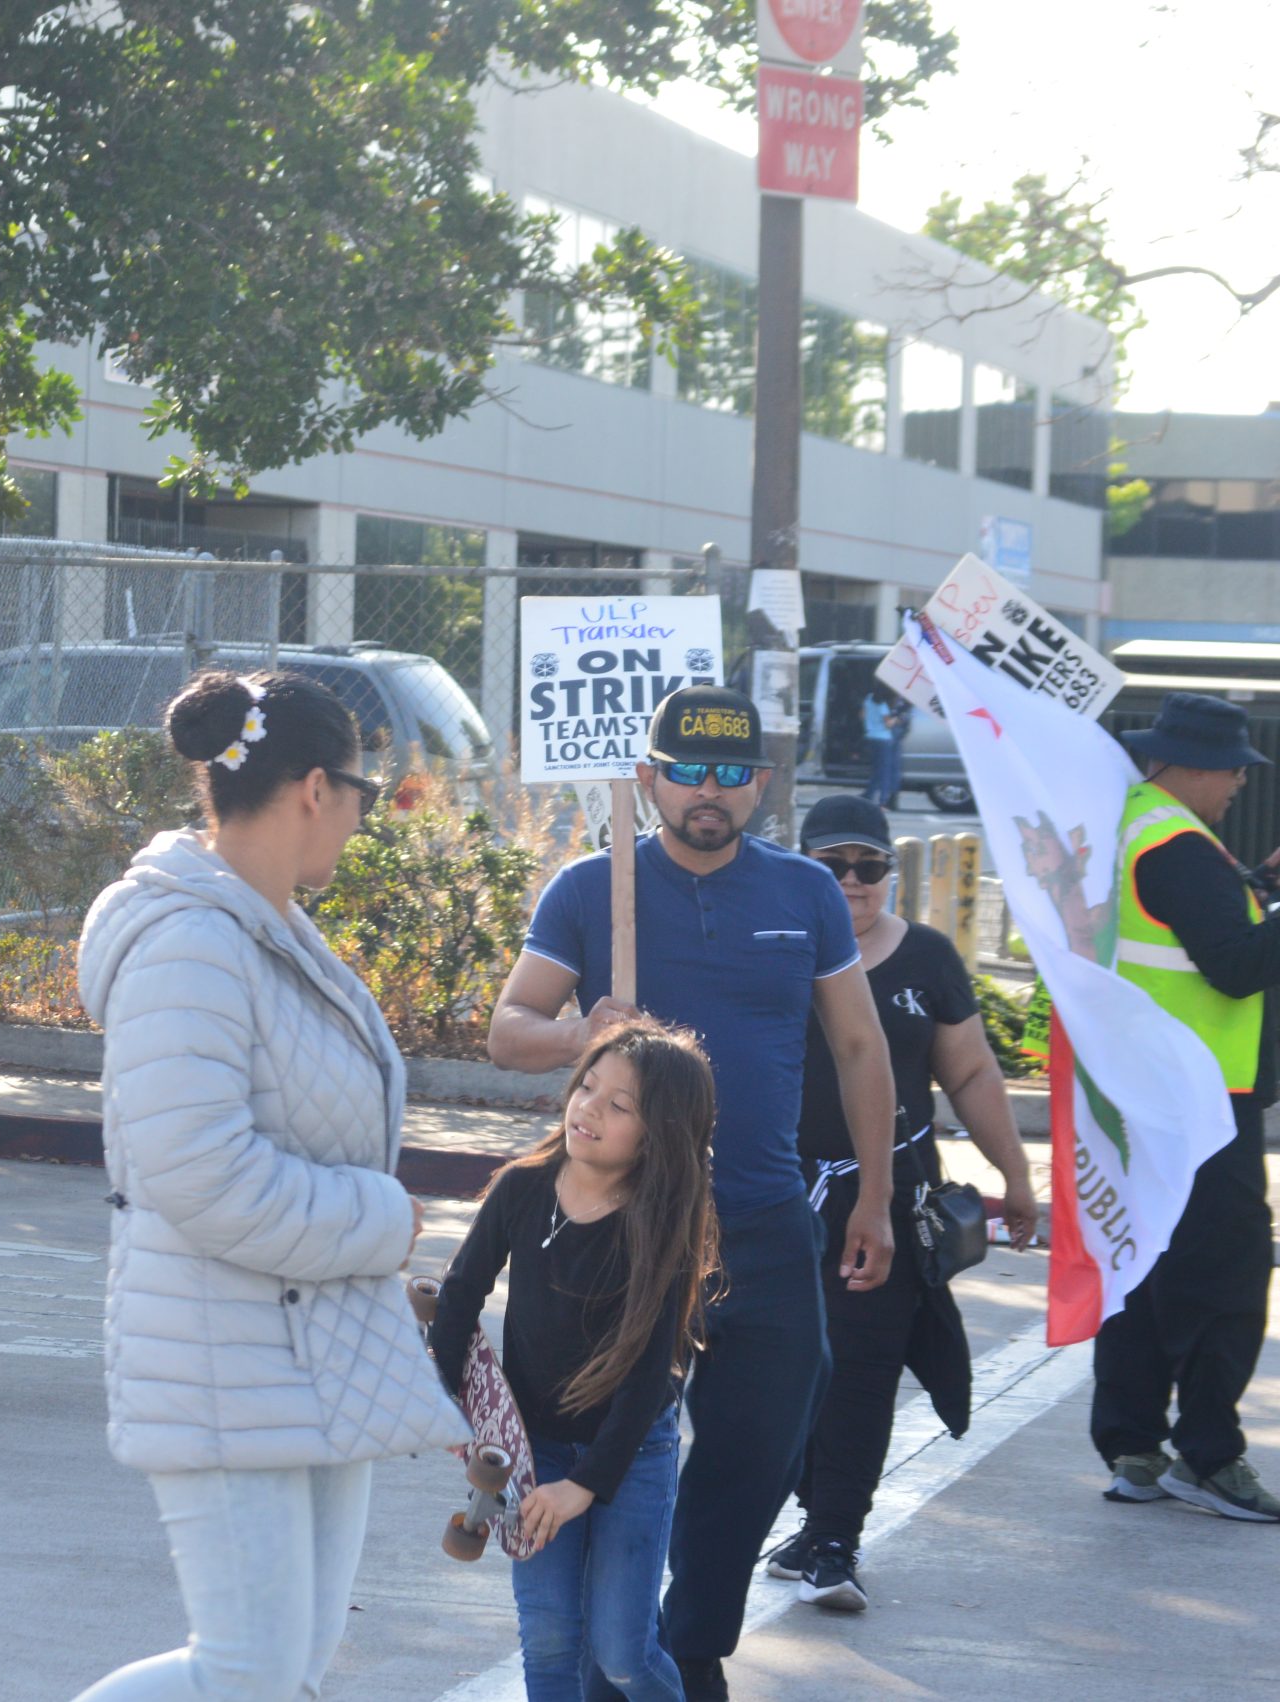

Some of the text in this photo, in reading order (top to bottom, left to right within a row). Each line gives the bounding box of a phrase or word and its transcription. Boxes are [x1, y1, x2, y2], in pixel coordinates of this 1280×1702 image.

[765, 84, 857, 131] WRONG
[783, 142, 838, 182] WAY
[581, 602, 647, 624] ULP
[550, 623, 675, 645] Transdev
[970, 629, 1008, 668] N
[998, 615, 1068, 691] IKE
[577, 648, 661, 675] ON
[530, 675, 715, 721] STRIK
[1062, 667, 1100, 710] 683
[538, 716, 654, 742] TEAMST
[723, 715, 750, 739] 683
[544, 738, 637, 763] LOCAL
[1074, 1132, 1137, 1271] PUBLIC
